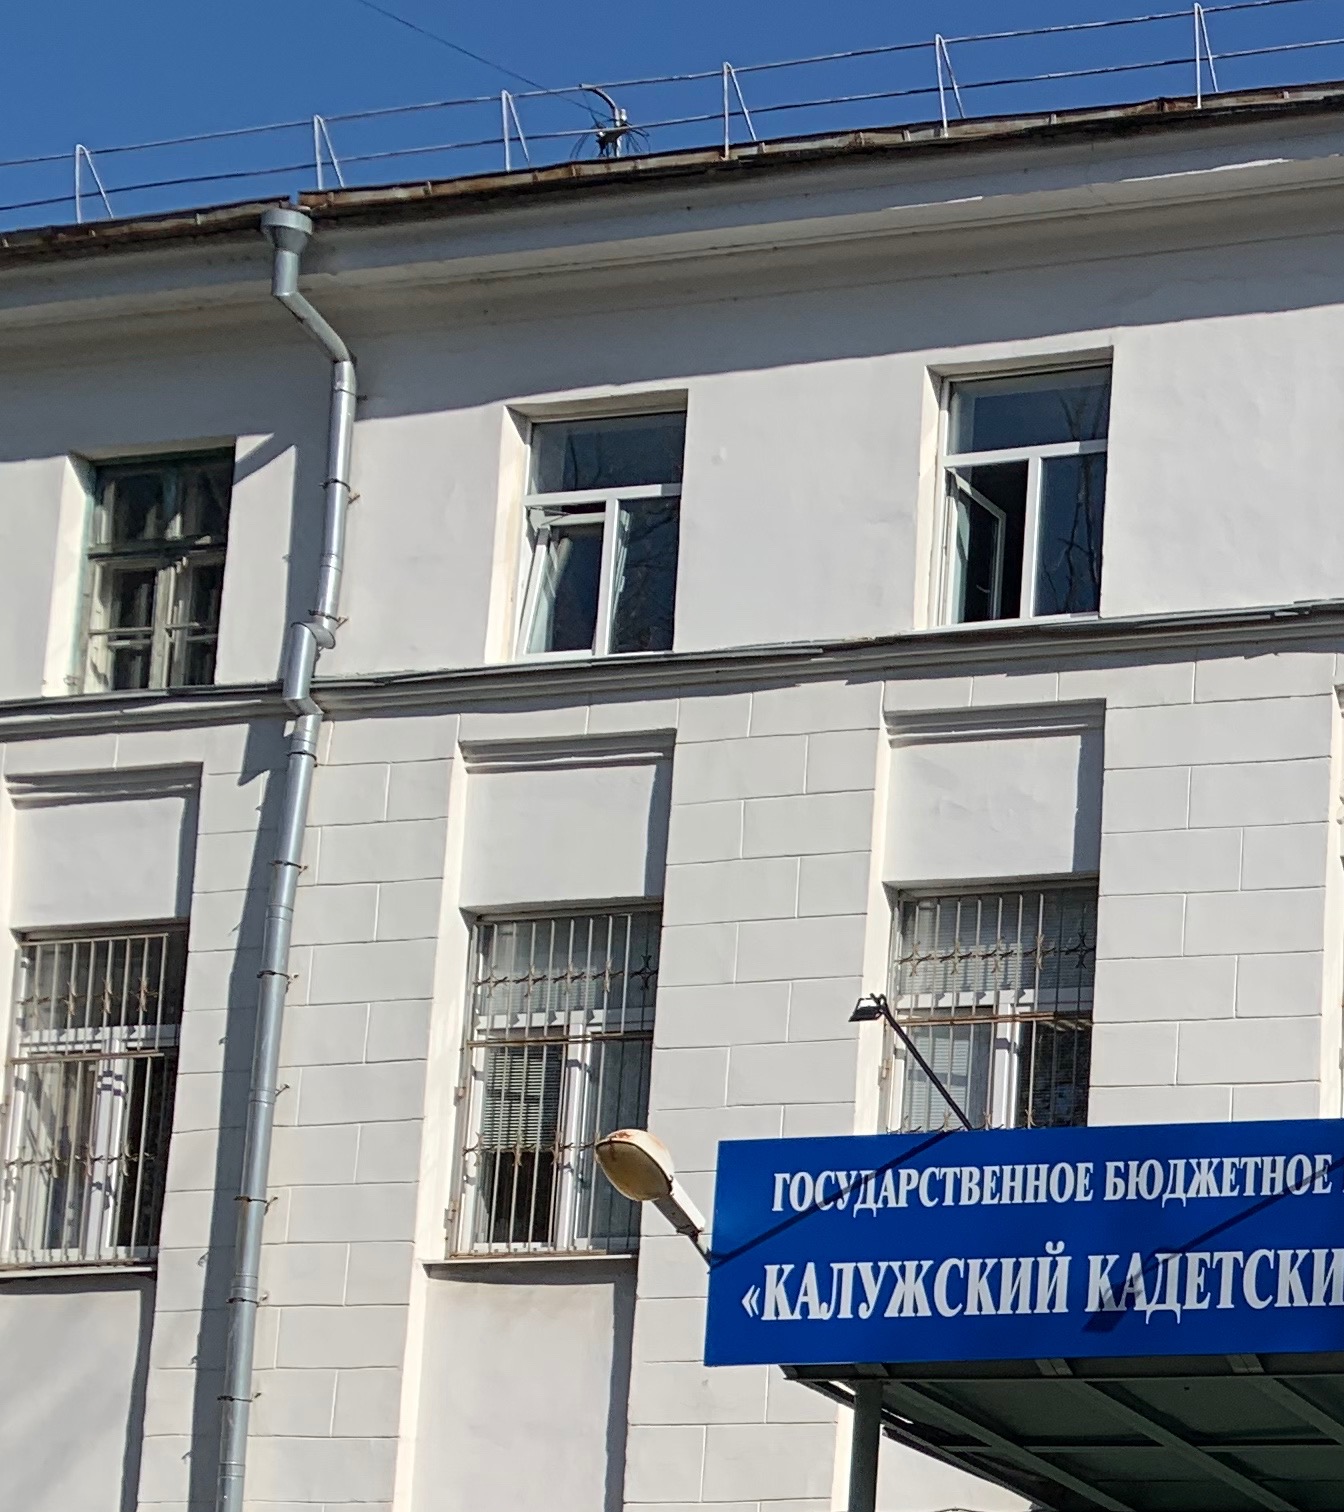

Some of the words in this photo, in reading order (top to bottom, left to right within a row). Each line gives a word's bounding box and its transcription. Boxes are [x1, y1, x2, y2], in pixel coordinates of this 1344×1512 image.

[772, 1160, 1094, 1217] ГОСУДАРСТВЕННОЕ
[1104, 1153, 1333, 1208] БЮДЖЕТНОЕ
[742, 1240, 1072, 1321] «КАЛУЖСКИЙ
